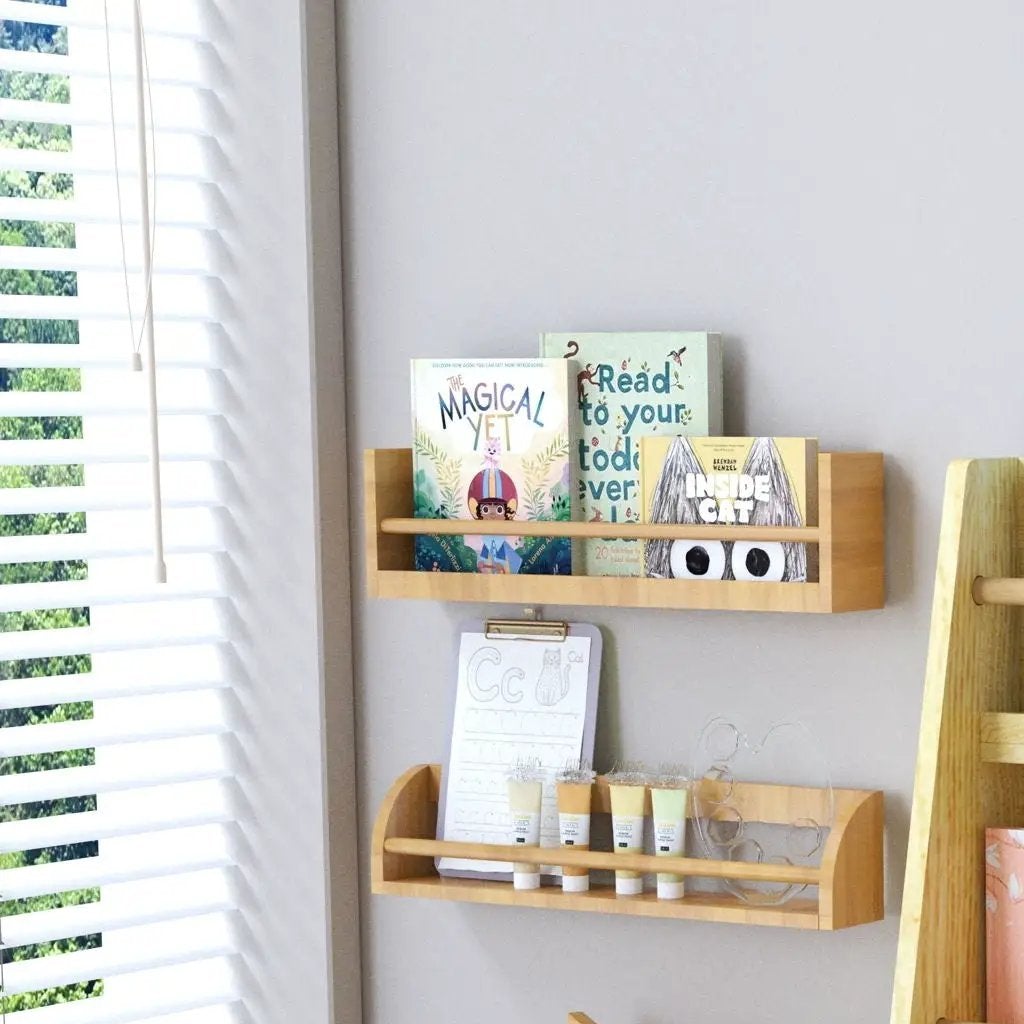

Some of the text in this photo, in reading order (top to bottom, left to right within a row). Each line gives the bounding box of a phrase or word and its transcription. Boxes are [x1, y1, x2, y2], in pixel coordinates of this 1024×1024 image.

[447, 374, 465, 393] THE
[599, 361, 671, 394] Read
[438, 382, 545, 430] MAGICAL
[579, 398, 686, 434] to your
[467, 414, 515, 451] YET
[686, 471, 771, 502] INSIDE
[700, 498, 754, 523] CAT
